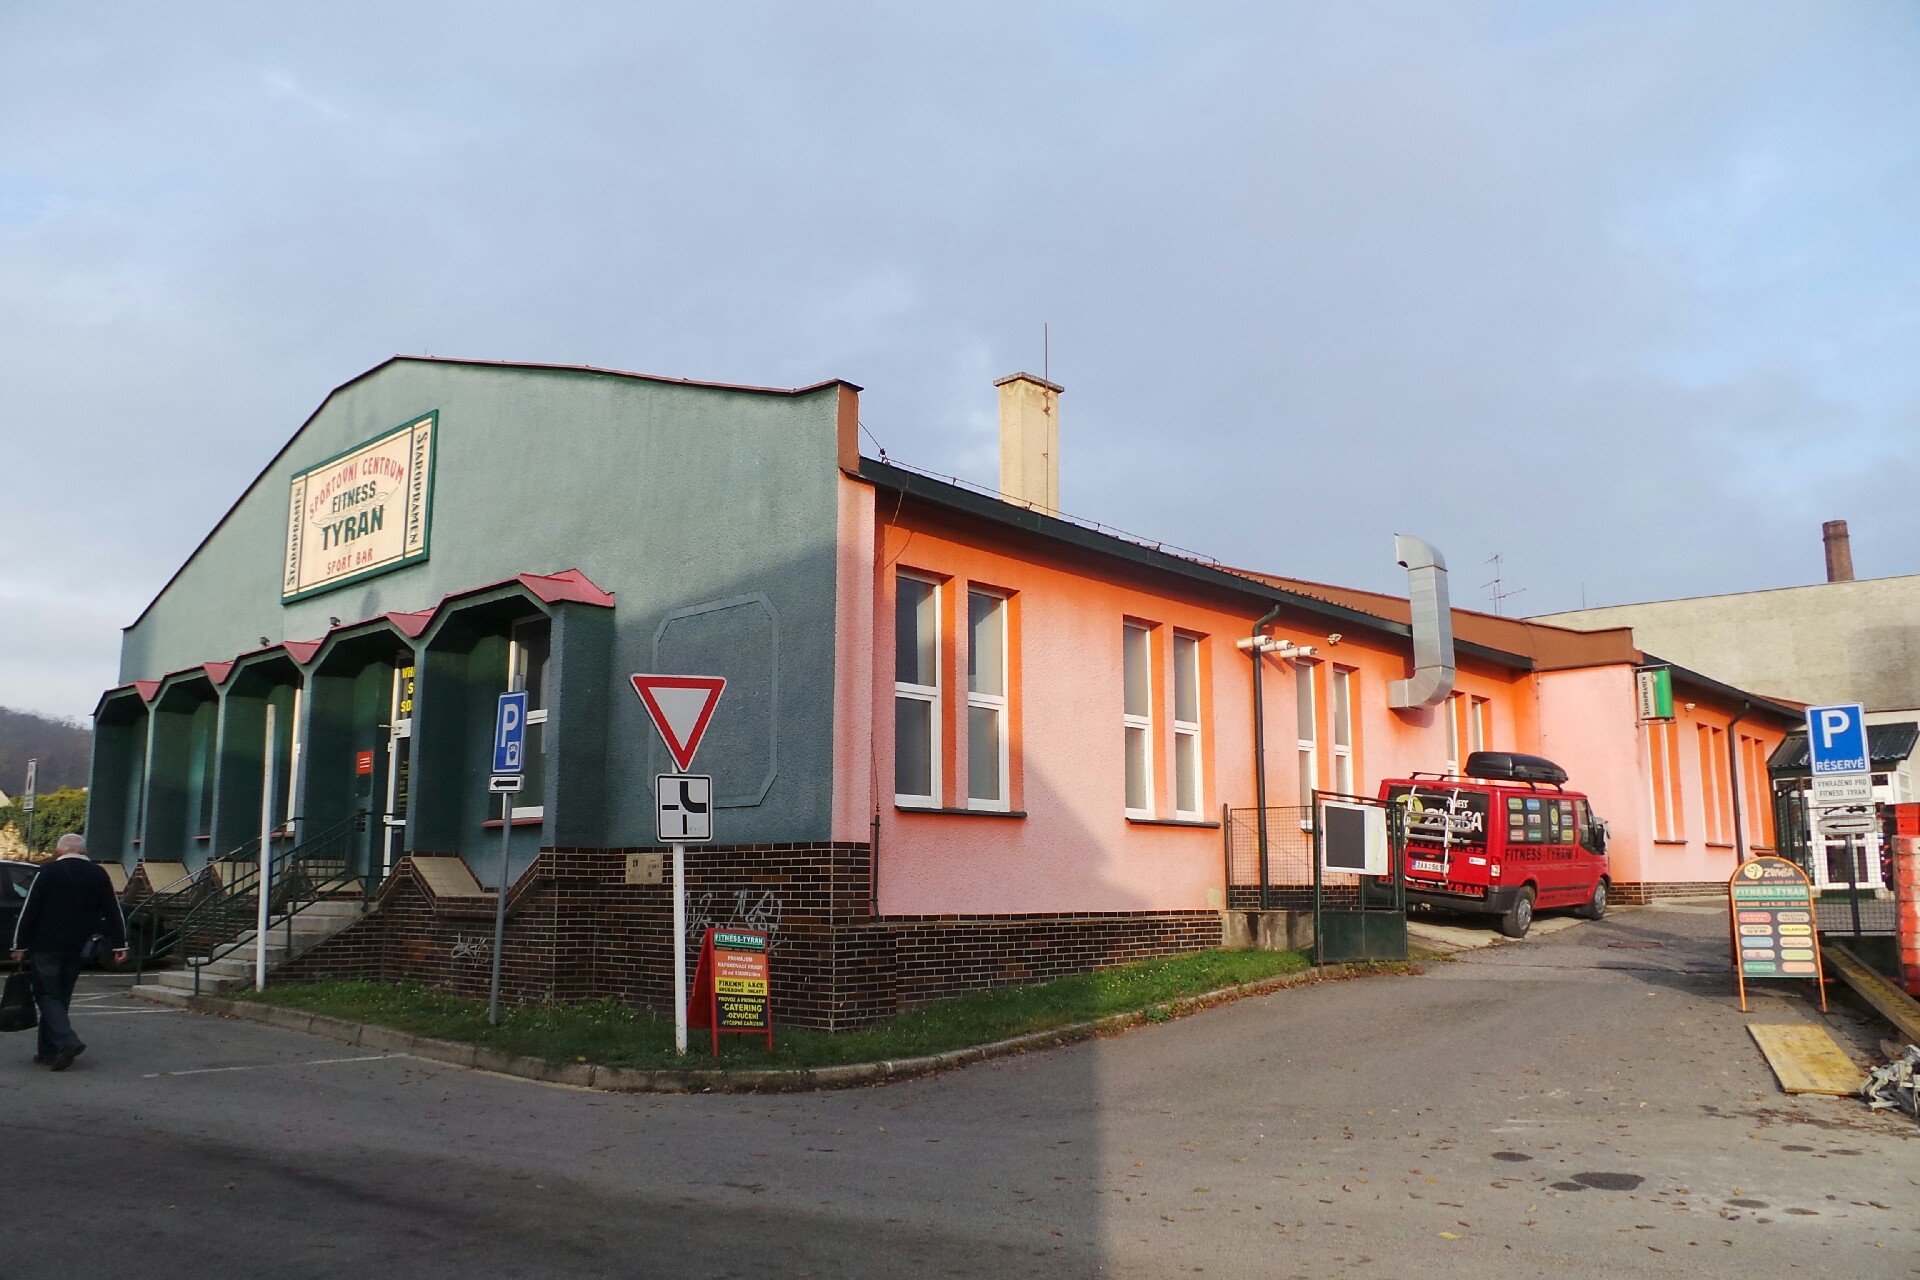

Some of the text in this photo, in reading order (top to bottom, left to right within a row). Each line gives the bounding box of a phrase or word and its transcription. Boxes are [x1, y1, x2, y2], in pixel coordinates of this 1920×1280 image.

[362, 456, 405, 485] CENTRUM
[332, 480, 377, 515] FITNESS
[409, 431, 429, 546] STAROPRAMEN
[322, 504, 385, 551] TYRAN
[326, 547, 374, 575] SPORT BAR
[400, 700, 412, 712] SO
[501, 703, 519, 748] P
[1821, 709, 1850, 749] P
[1816, 757, 1865, 771] RÉSERVÉ
[1817, 778, 1867, 788] VYHRAZENO PRO
